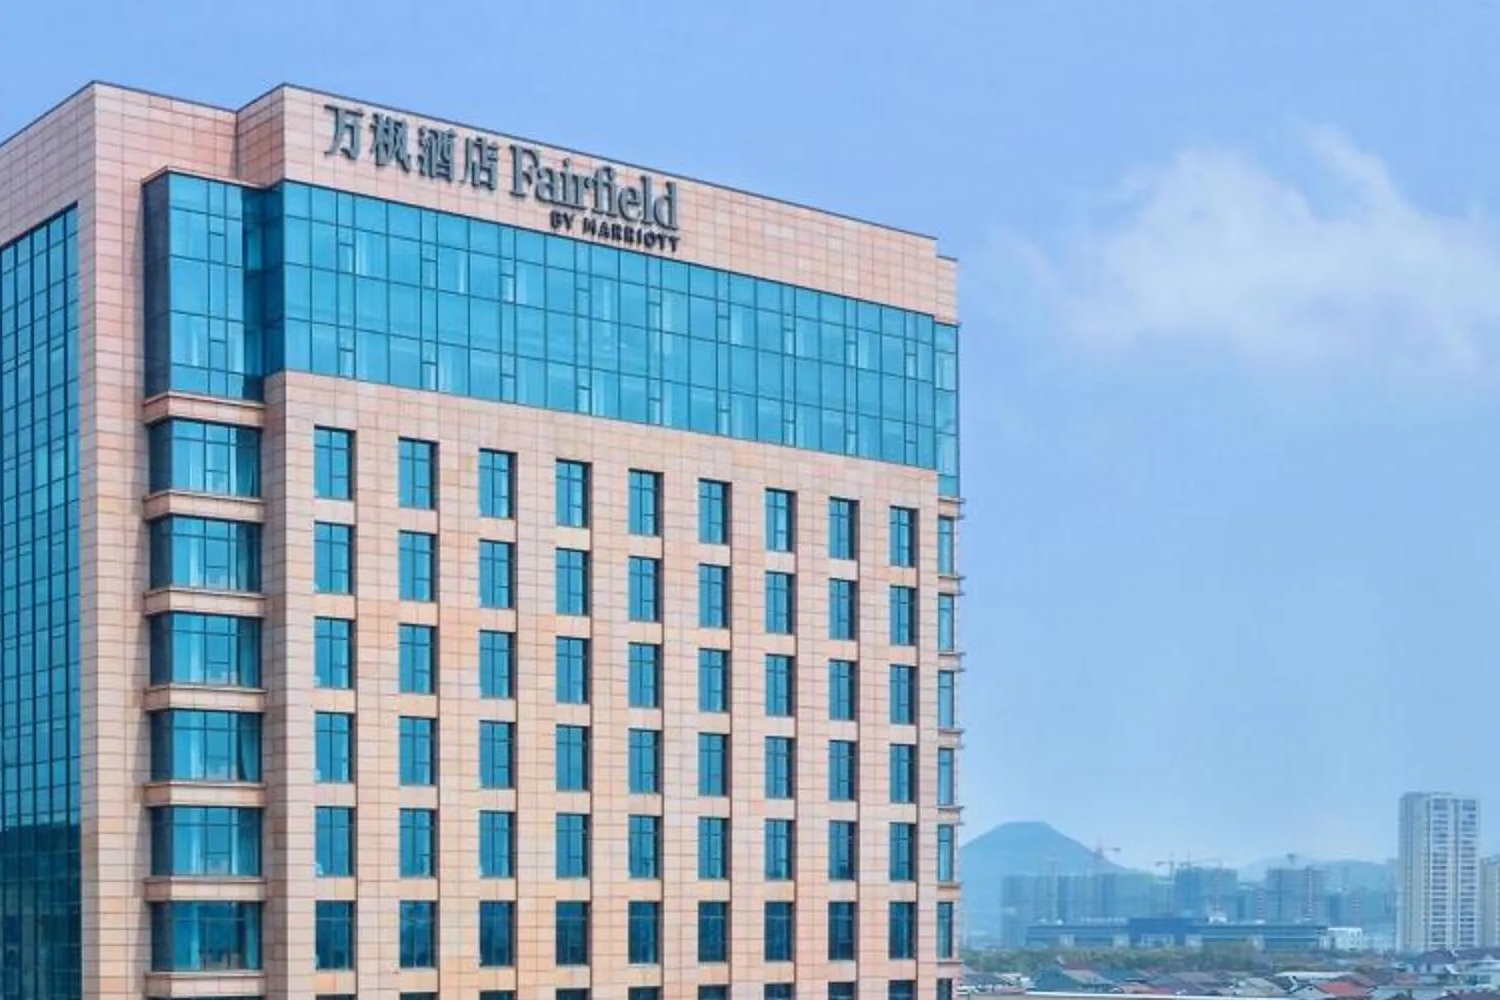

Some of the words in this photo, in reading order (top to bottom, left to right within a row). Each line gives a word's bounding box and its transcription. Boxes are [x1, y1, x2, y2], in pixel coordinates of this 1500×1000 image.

[324, 104, 498, 190] 万枫酒店
[509, 144, 678, 230] Fairfield
[550, 210, 574, 230] BY
[583, 217, 680, 252] MARRIOTT
